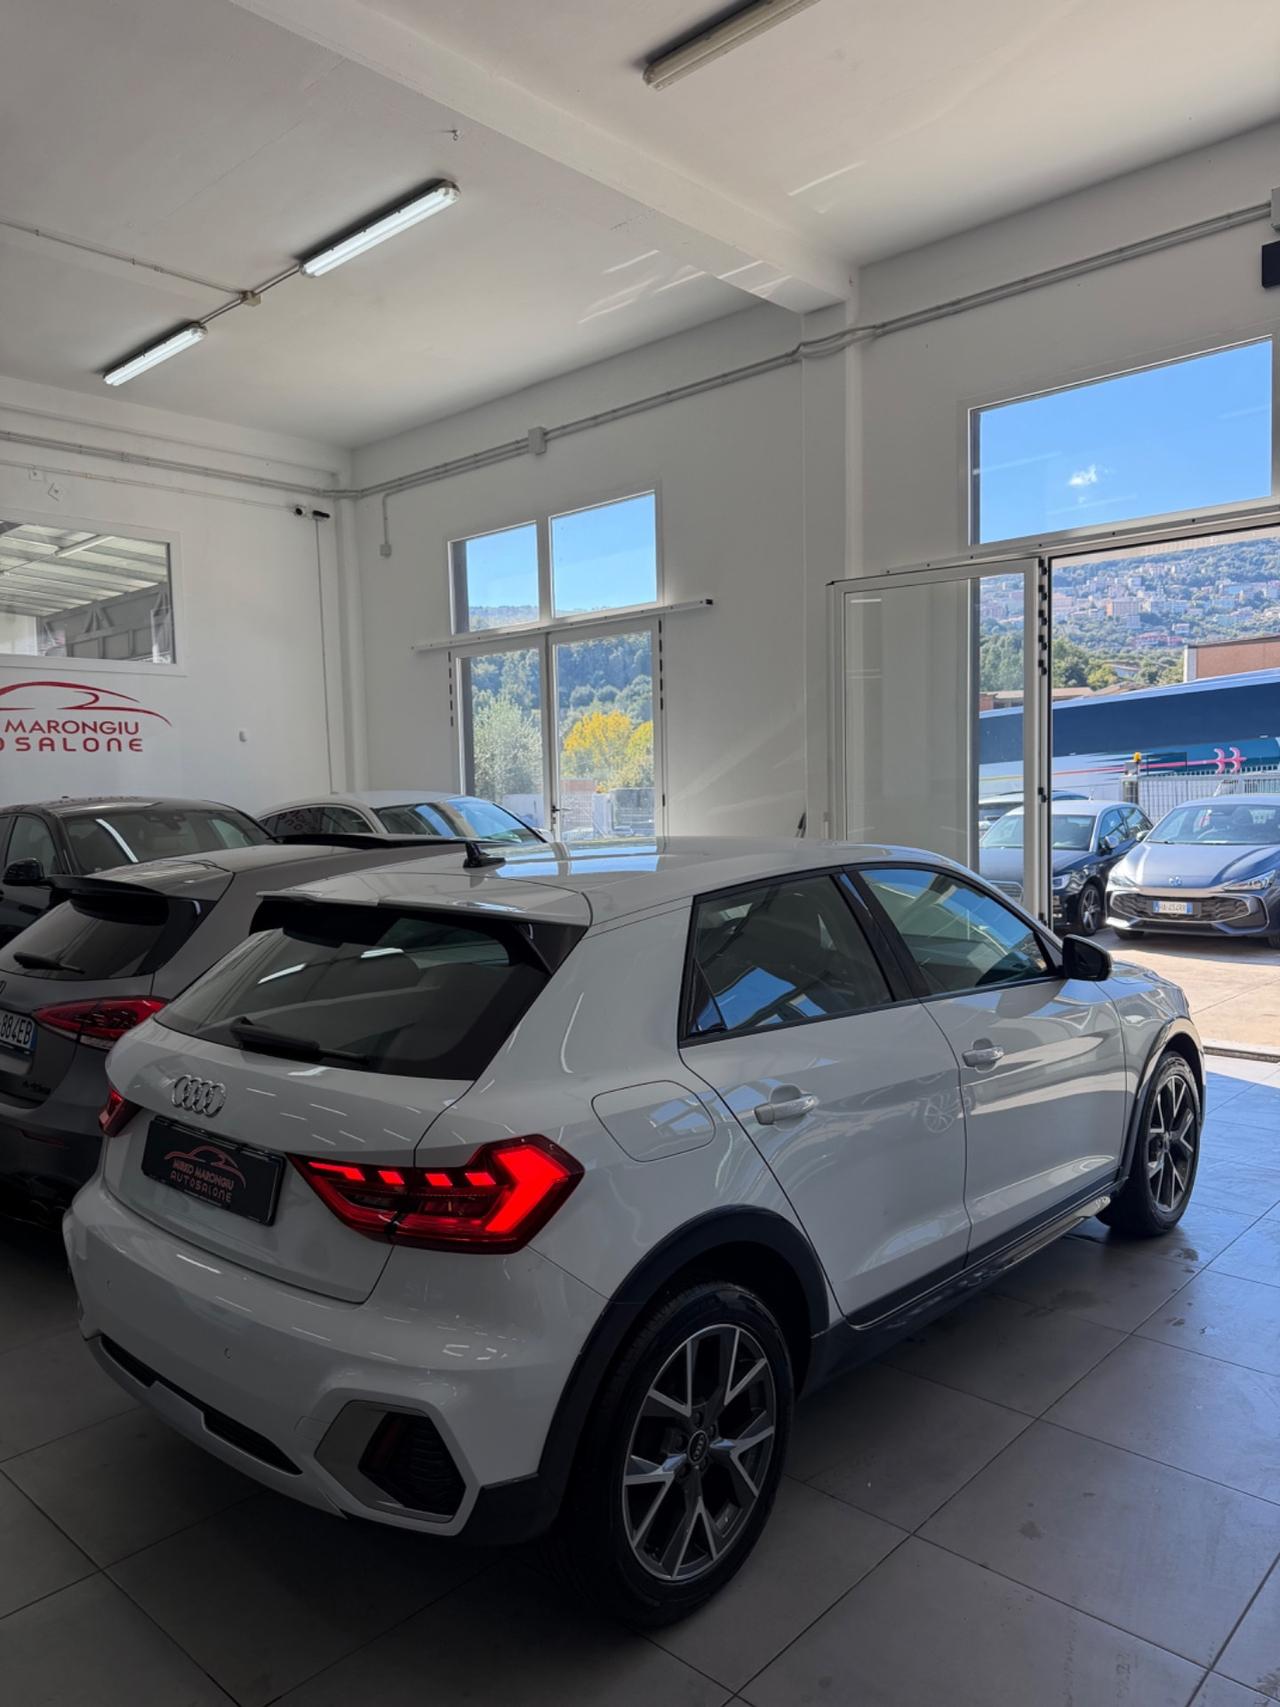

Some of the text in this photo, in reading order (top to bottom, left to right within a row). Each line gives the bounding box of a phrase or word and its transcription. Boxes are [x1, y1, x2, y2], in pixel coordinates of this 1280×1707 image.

[5, 719, 139, 735] MARONGIU
[0, 737, 143, 752] SALONE
[169, 1170, 233, 1203] AUTOSALONE
